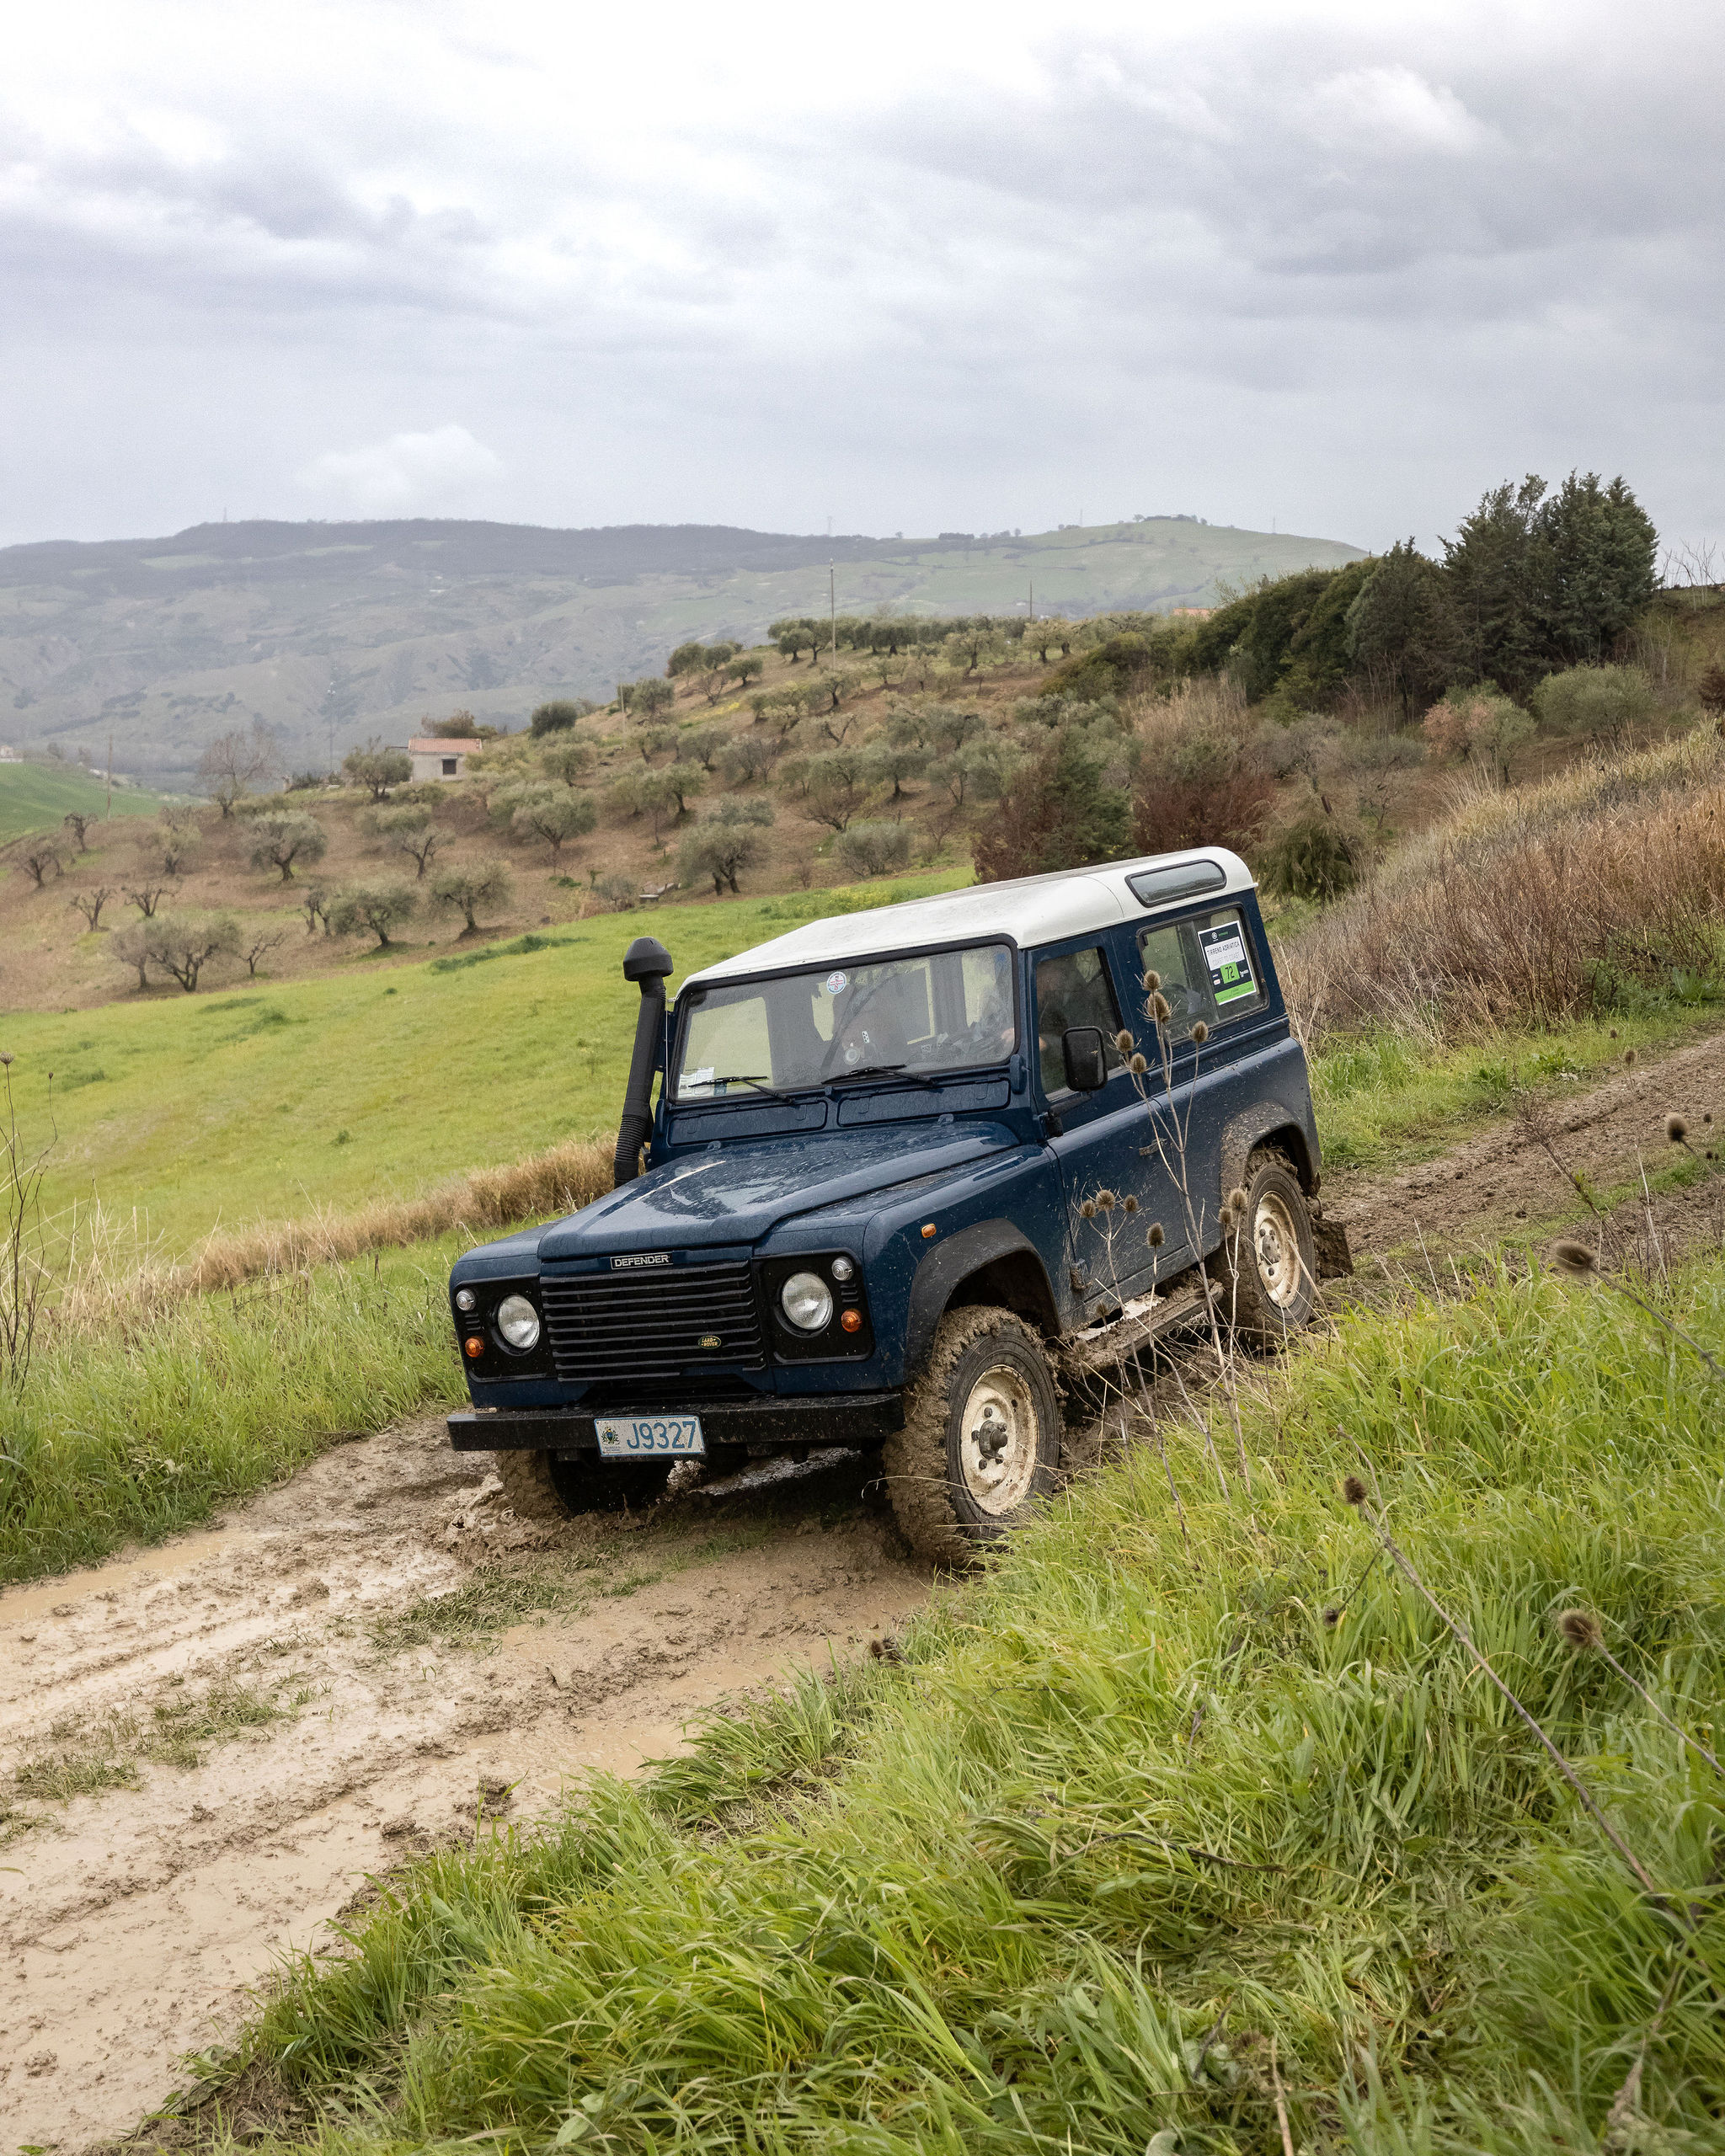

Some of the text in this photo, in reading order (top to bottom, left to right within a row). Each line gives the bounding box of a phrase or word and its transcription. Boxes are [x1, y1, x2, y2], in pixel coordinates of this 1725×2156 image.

[1207, 941, 1240, 955] TIRRENO ADRIATICA
[1225, 965, 1235, 979] 72
[614, 1254, 669, 1267] DEFENDER
[627, 1420, 696, 1449] J9327
